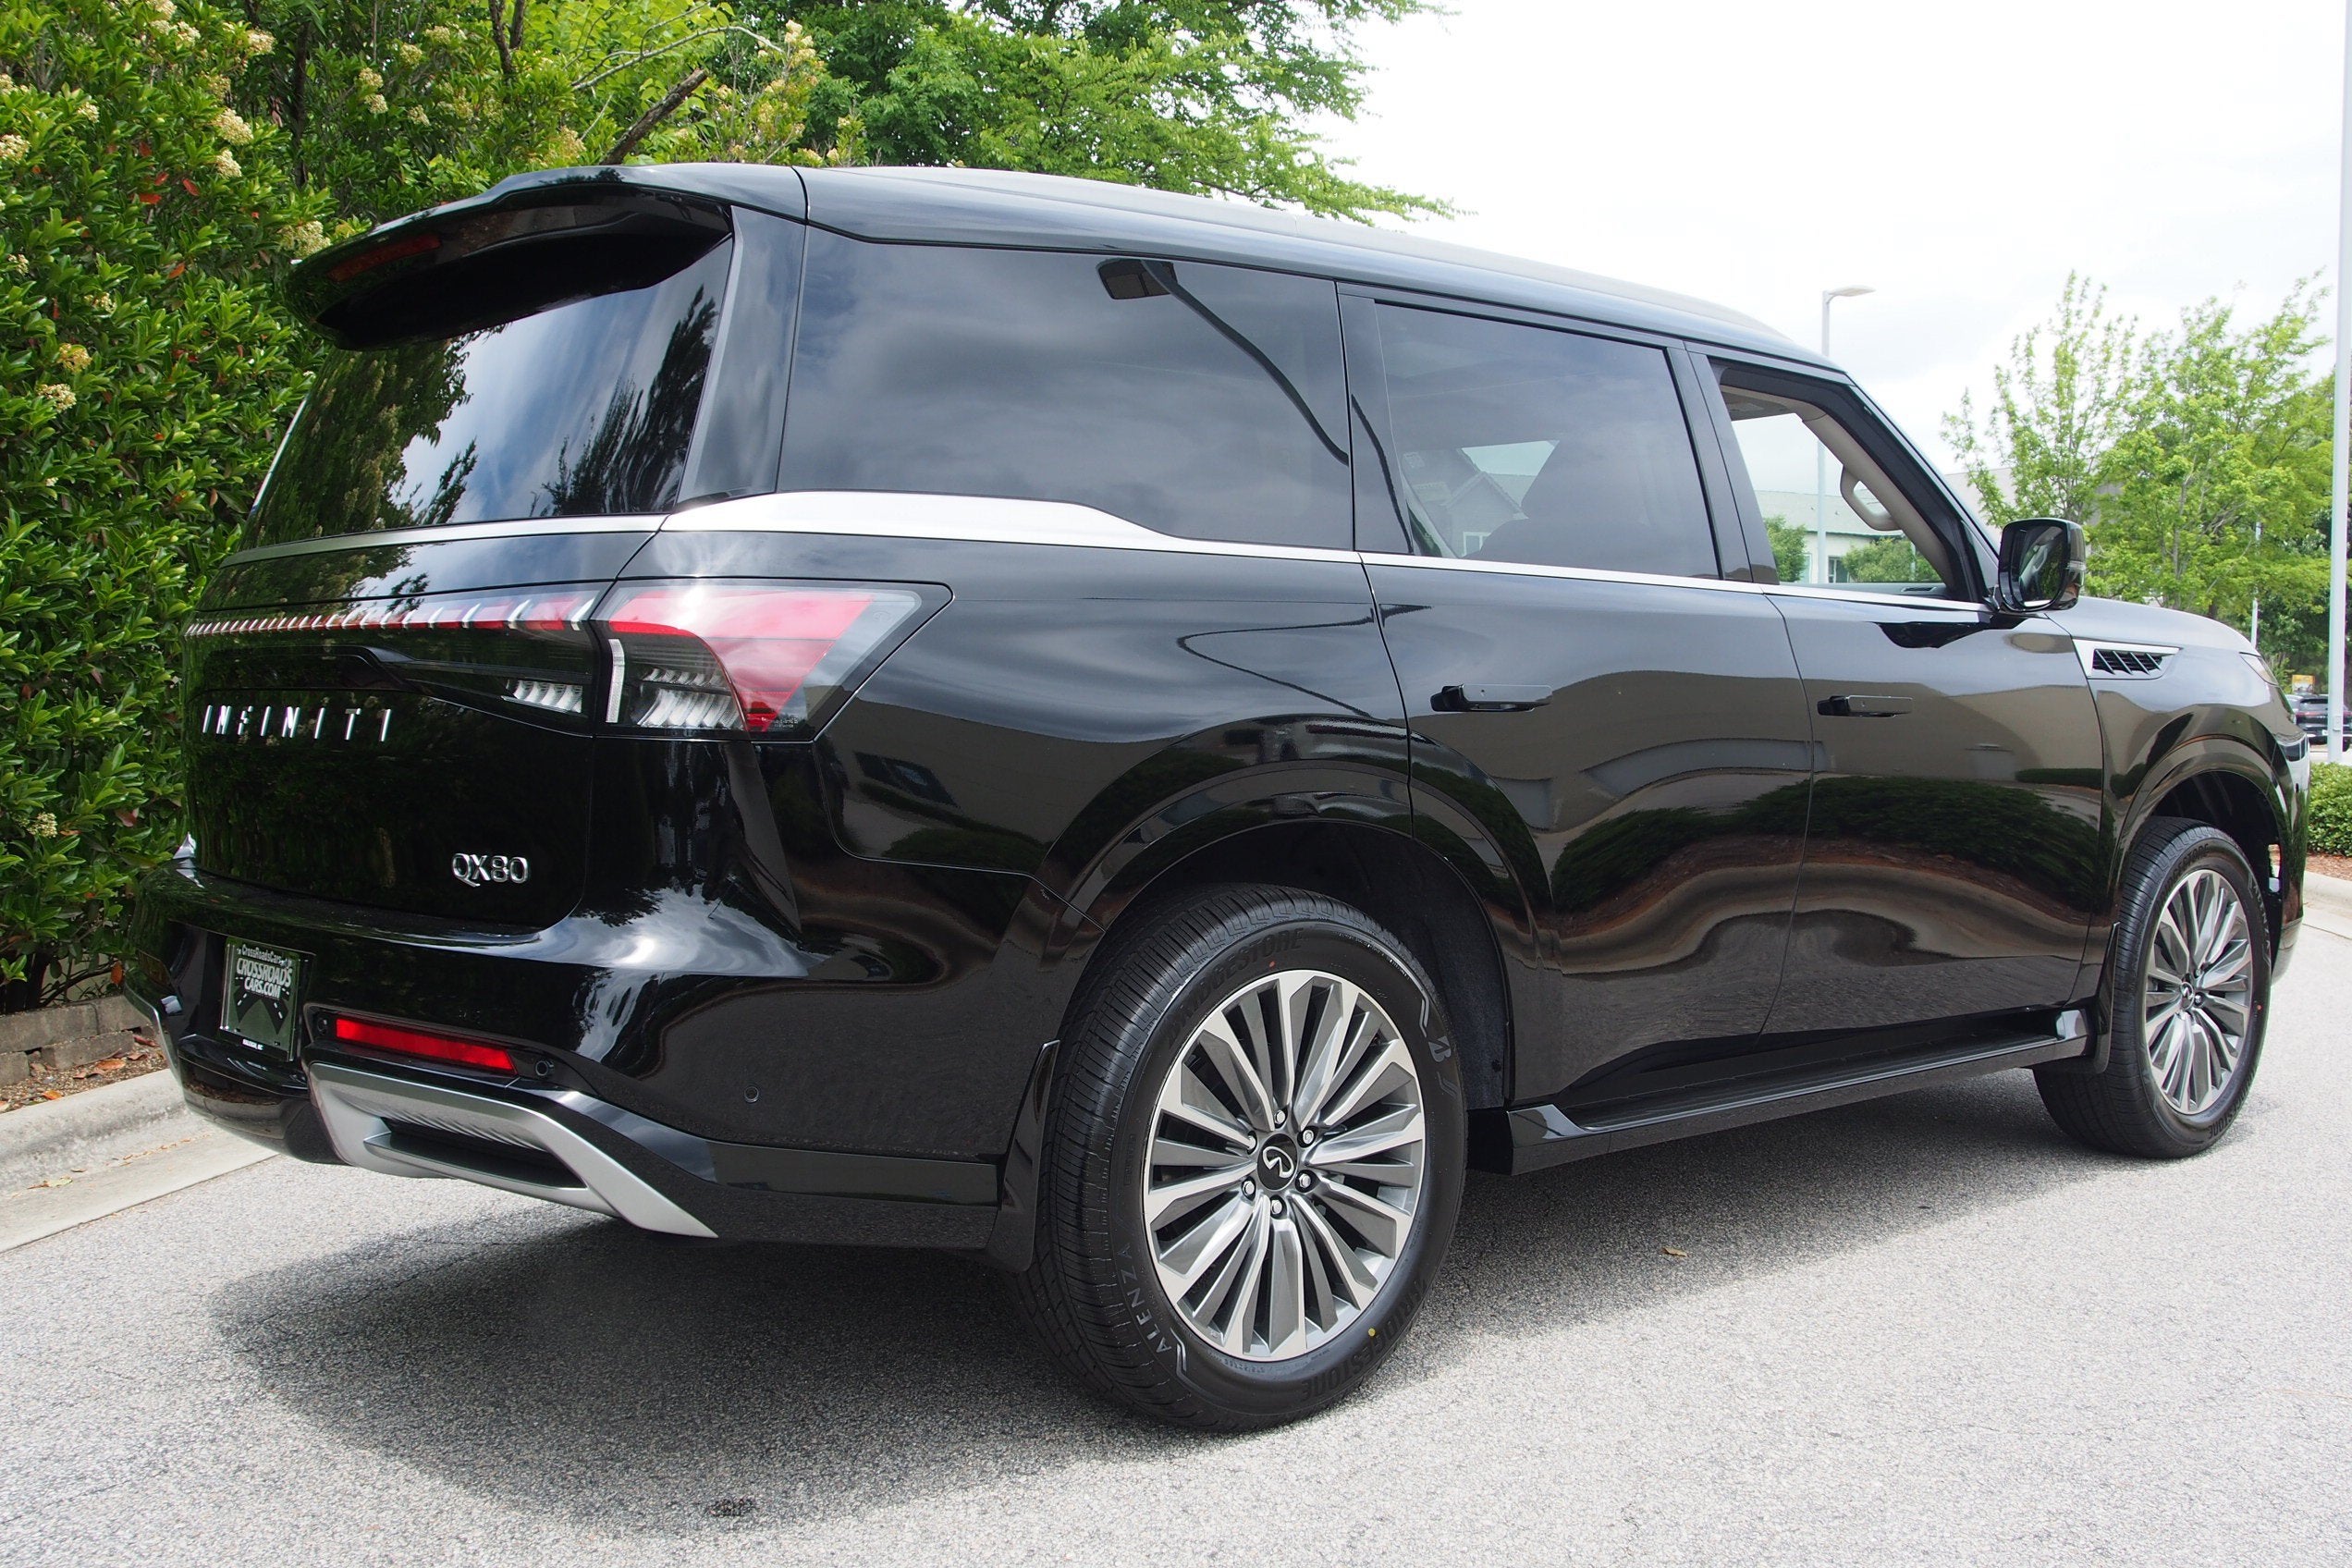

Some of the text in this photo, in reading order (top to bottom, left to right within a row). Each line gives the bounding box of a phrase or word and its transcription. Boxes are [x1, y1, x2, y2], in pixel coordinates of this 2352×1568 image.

[202, 704, 393, 742] INFINITI
[452, 852, 529, 888] QX80
[236, 957, 293, 987] CROSSROADS
[244, 976, 282, 999] CARS.COM
[1116, 1243, 1172, 1354] ALENZA
